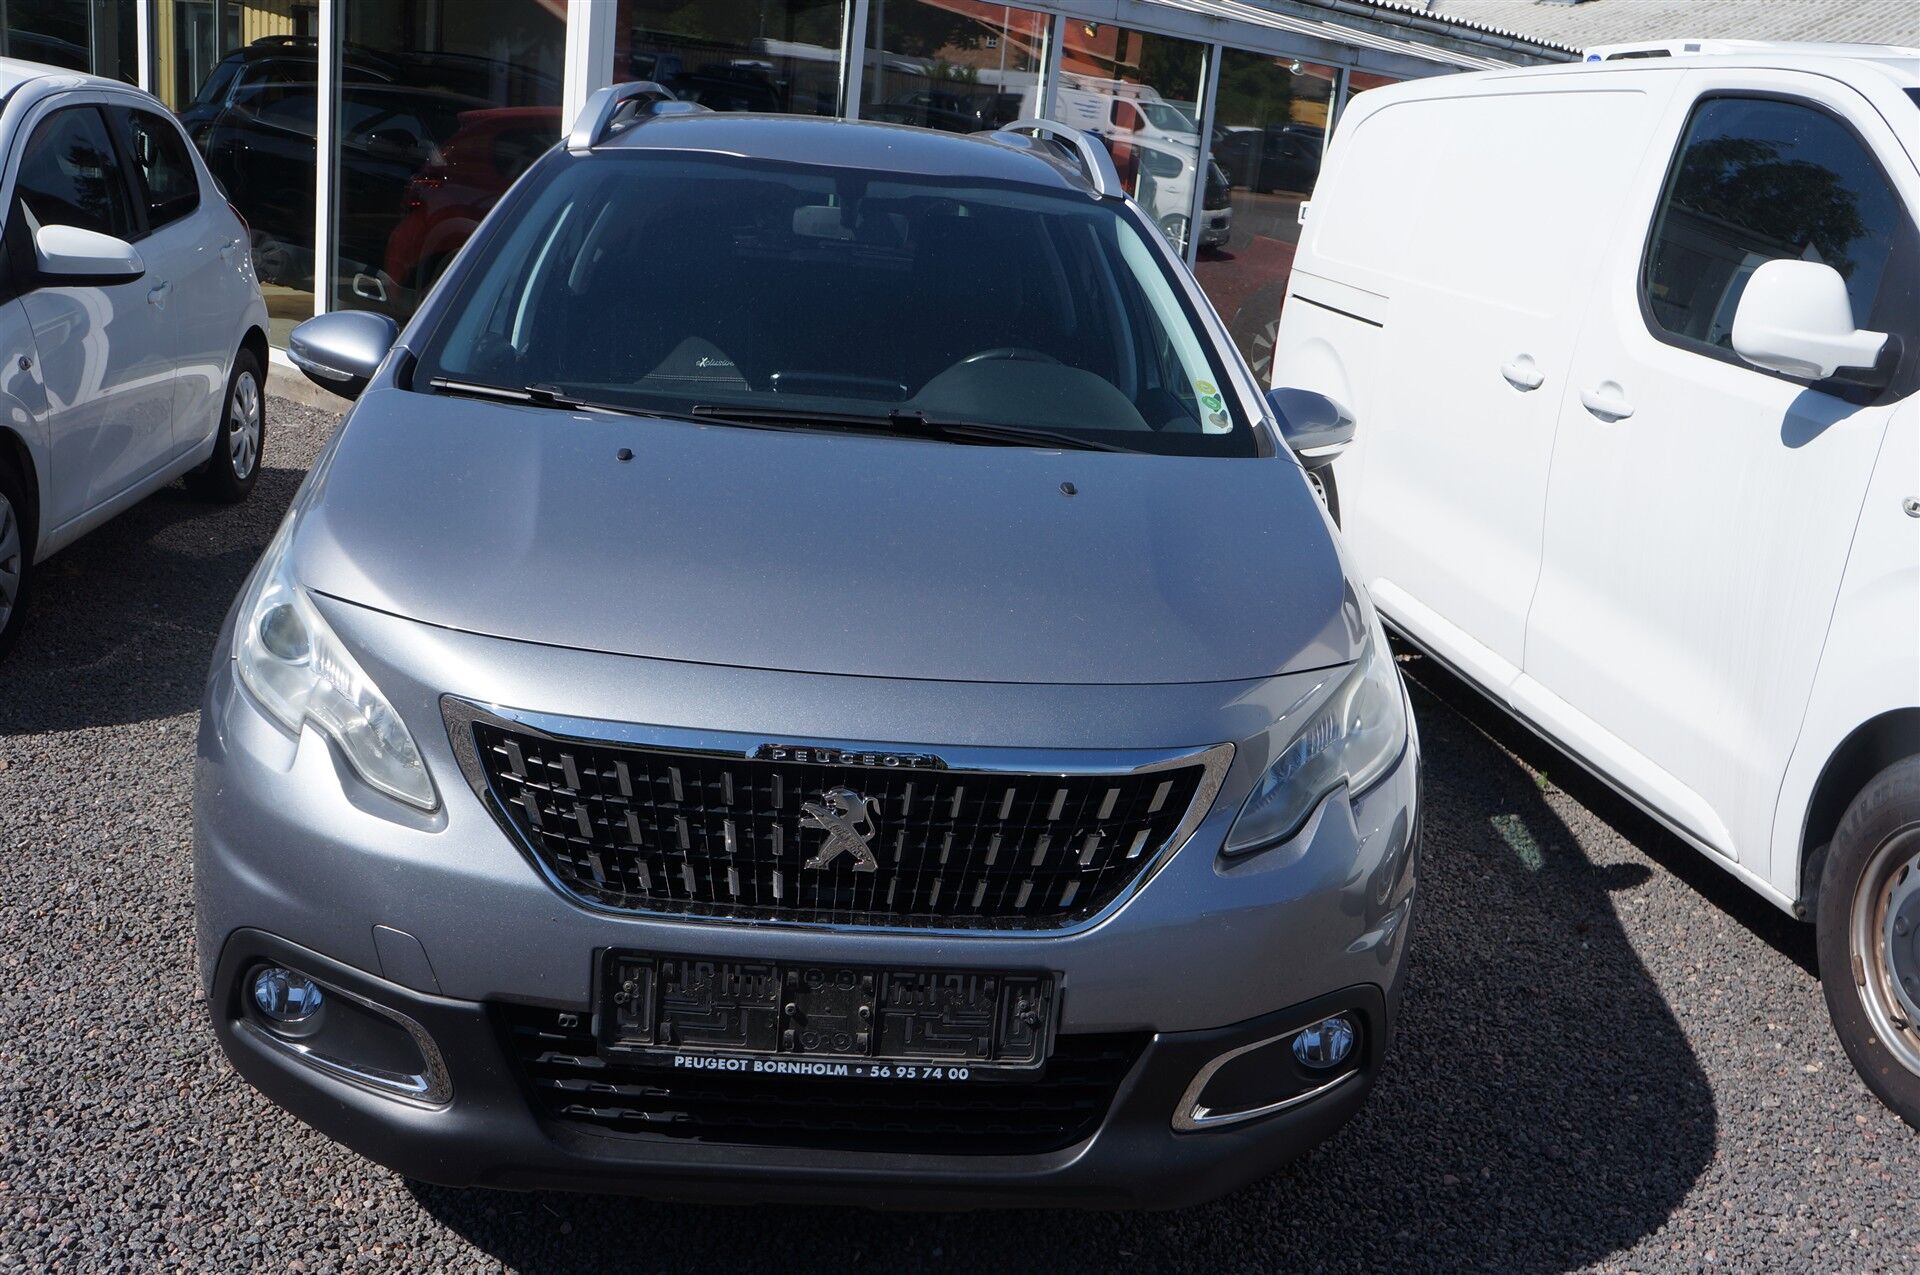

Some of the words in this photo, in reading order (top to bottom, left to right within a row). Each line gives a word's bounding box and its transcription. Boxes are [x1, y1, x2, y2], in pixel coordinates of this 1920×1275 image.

[772, 749, 921, 768] PEUGEOT
[674, 1055, 748, 1072] PEUGEOT
[753, 1060, 848, 1076] BORNHOLM
[870, 1066, 890, 1078] 56
[896, 1066, 916, 1079] 95
[922, 1067, 943, 1079] 74
[948, 1068, 969, 1080] 00
